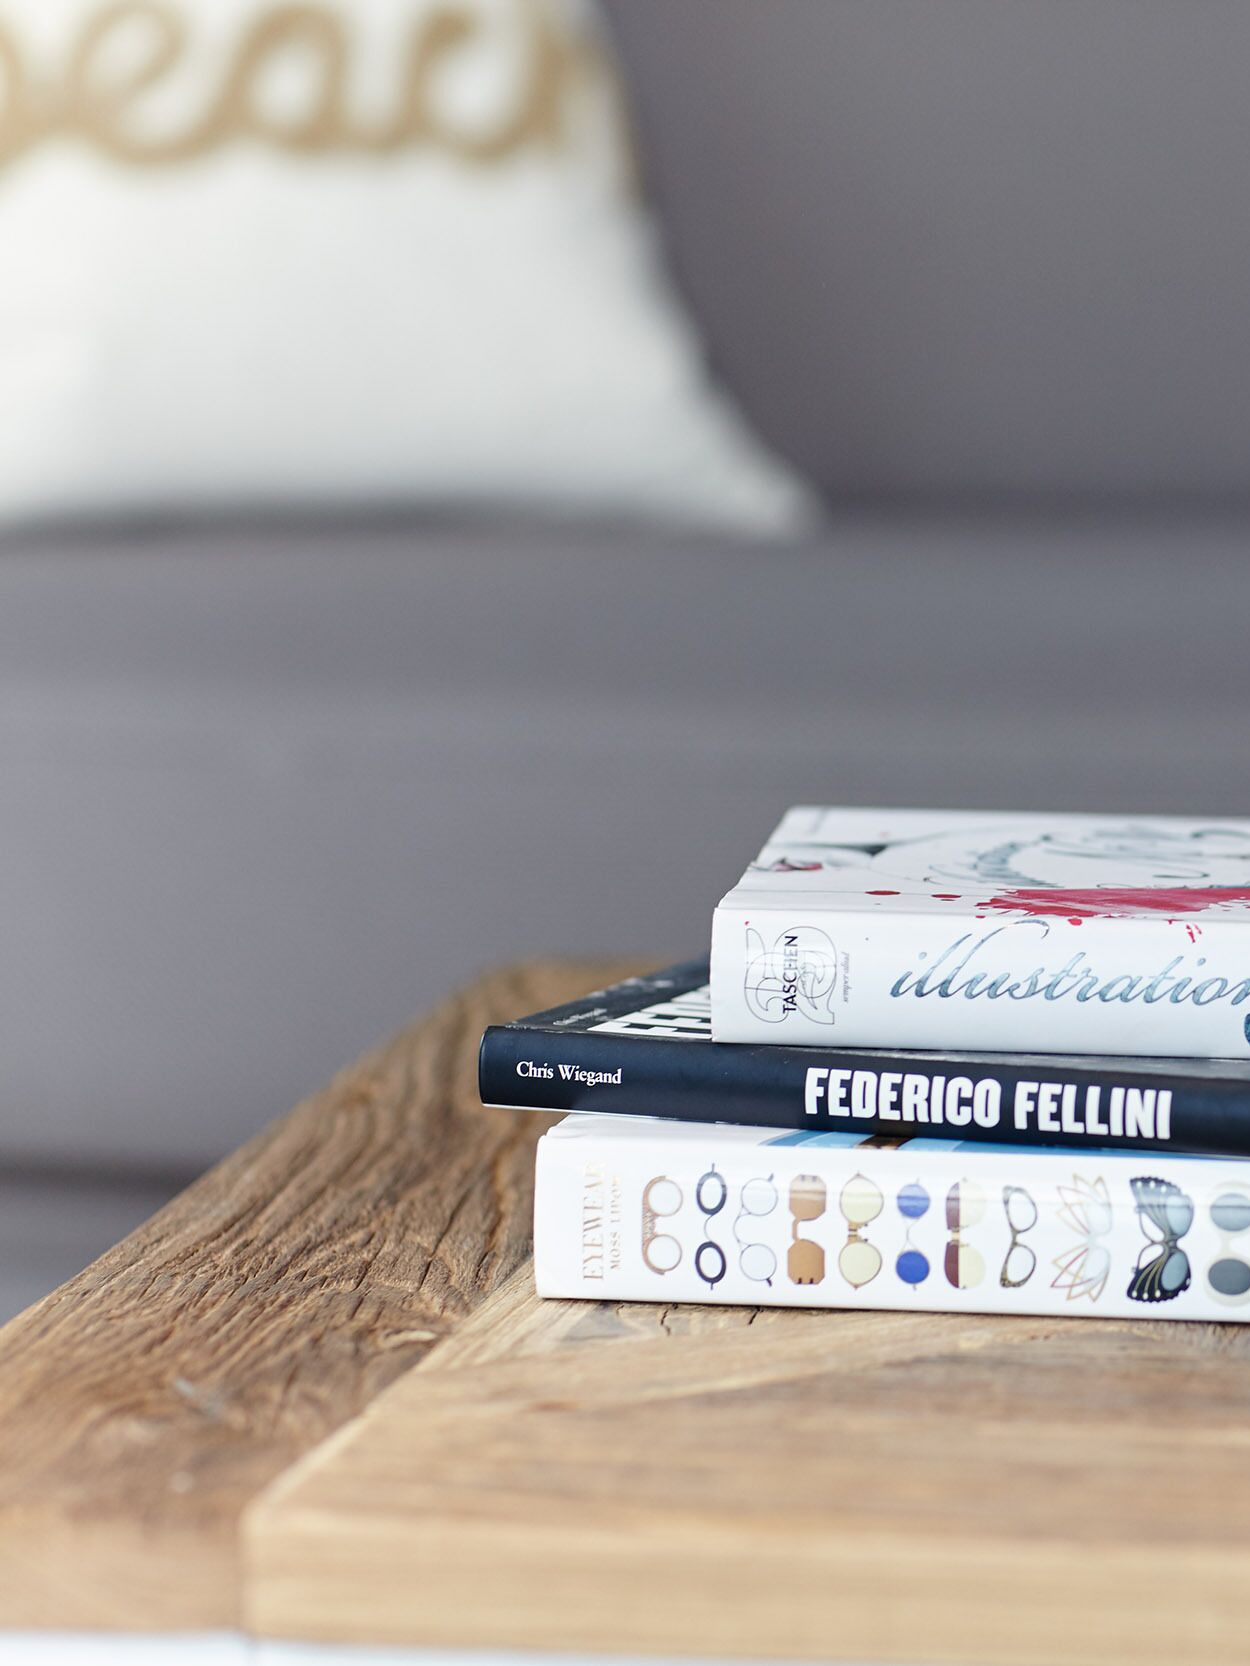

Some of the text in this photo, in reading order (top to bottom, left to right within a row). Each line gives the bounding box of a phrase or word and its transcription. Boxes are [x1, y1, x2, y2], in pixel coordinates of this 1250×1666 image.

[782, 935, 798, 1014] TASCHEN
[516, 1060, 623, 1087] Chris Wiegand
[804, 1067, 1173, 1140] FEDERICO FELLINI
[610, 1231, 621, 1270] MOSS
